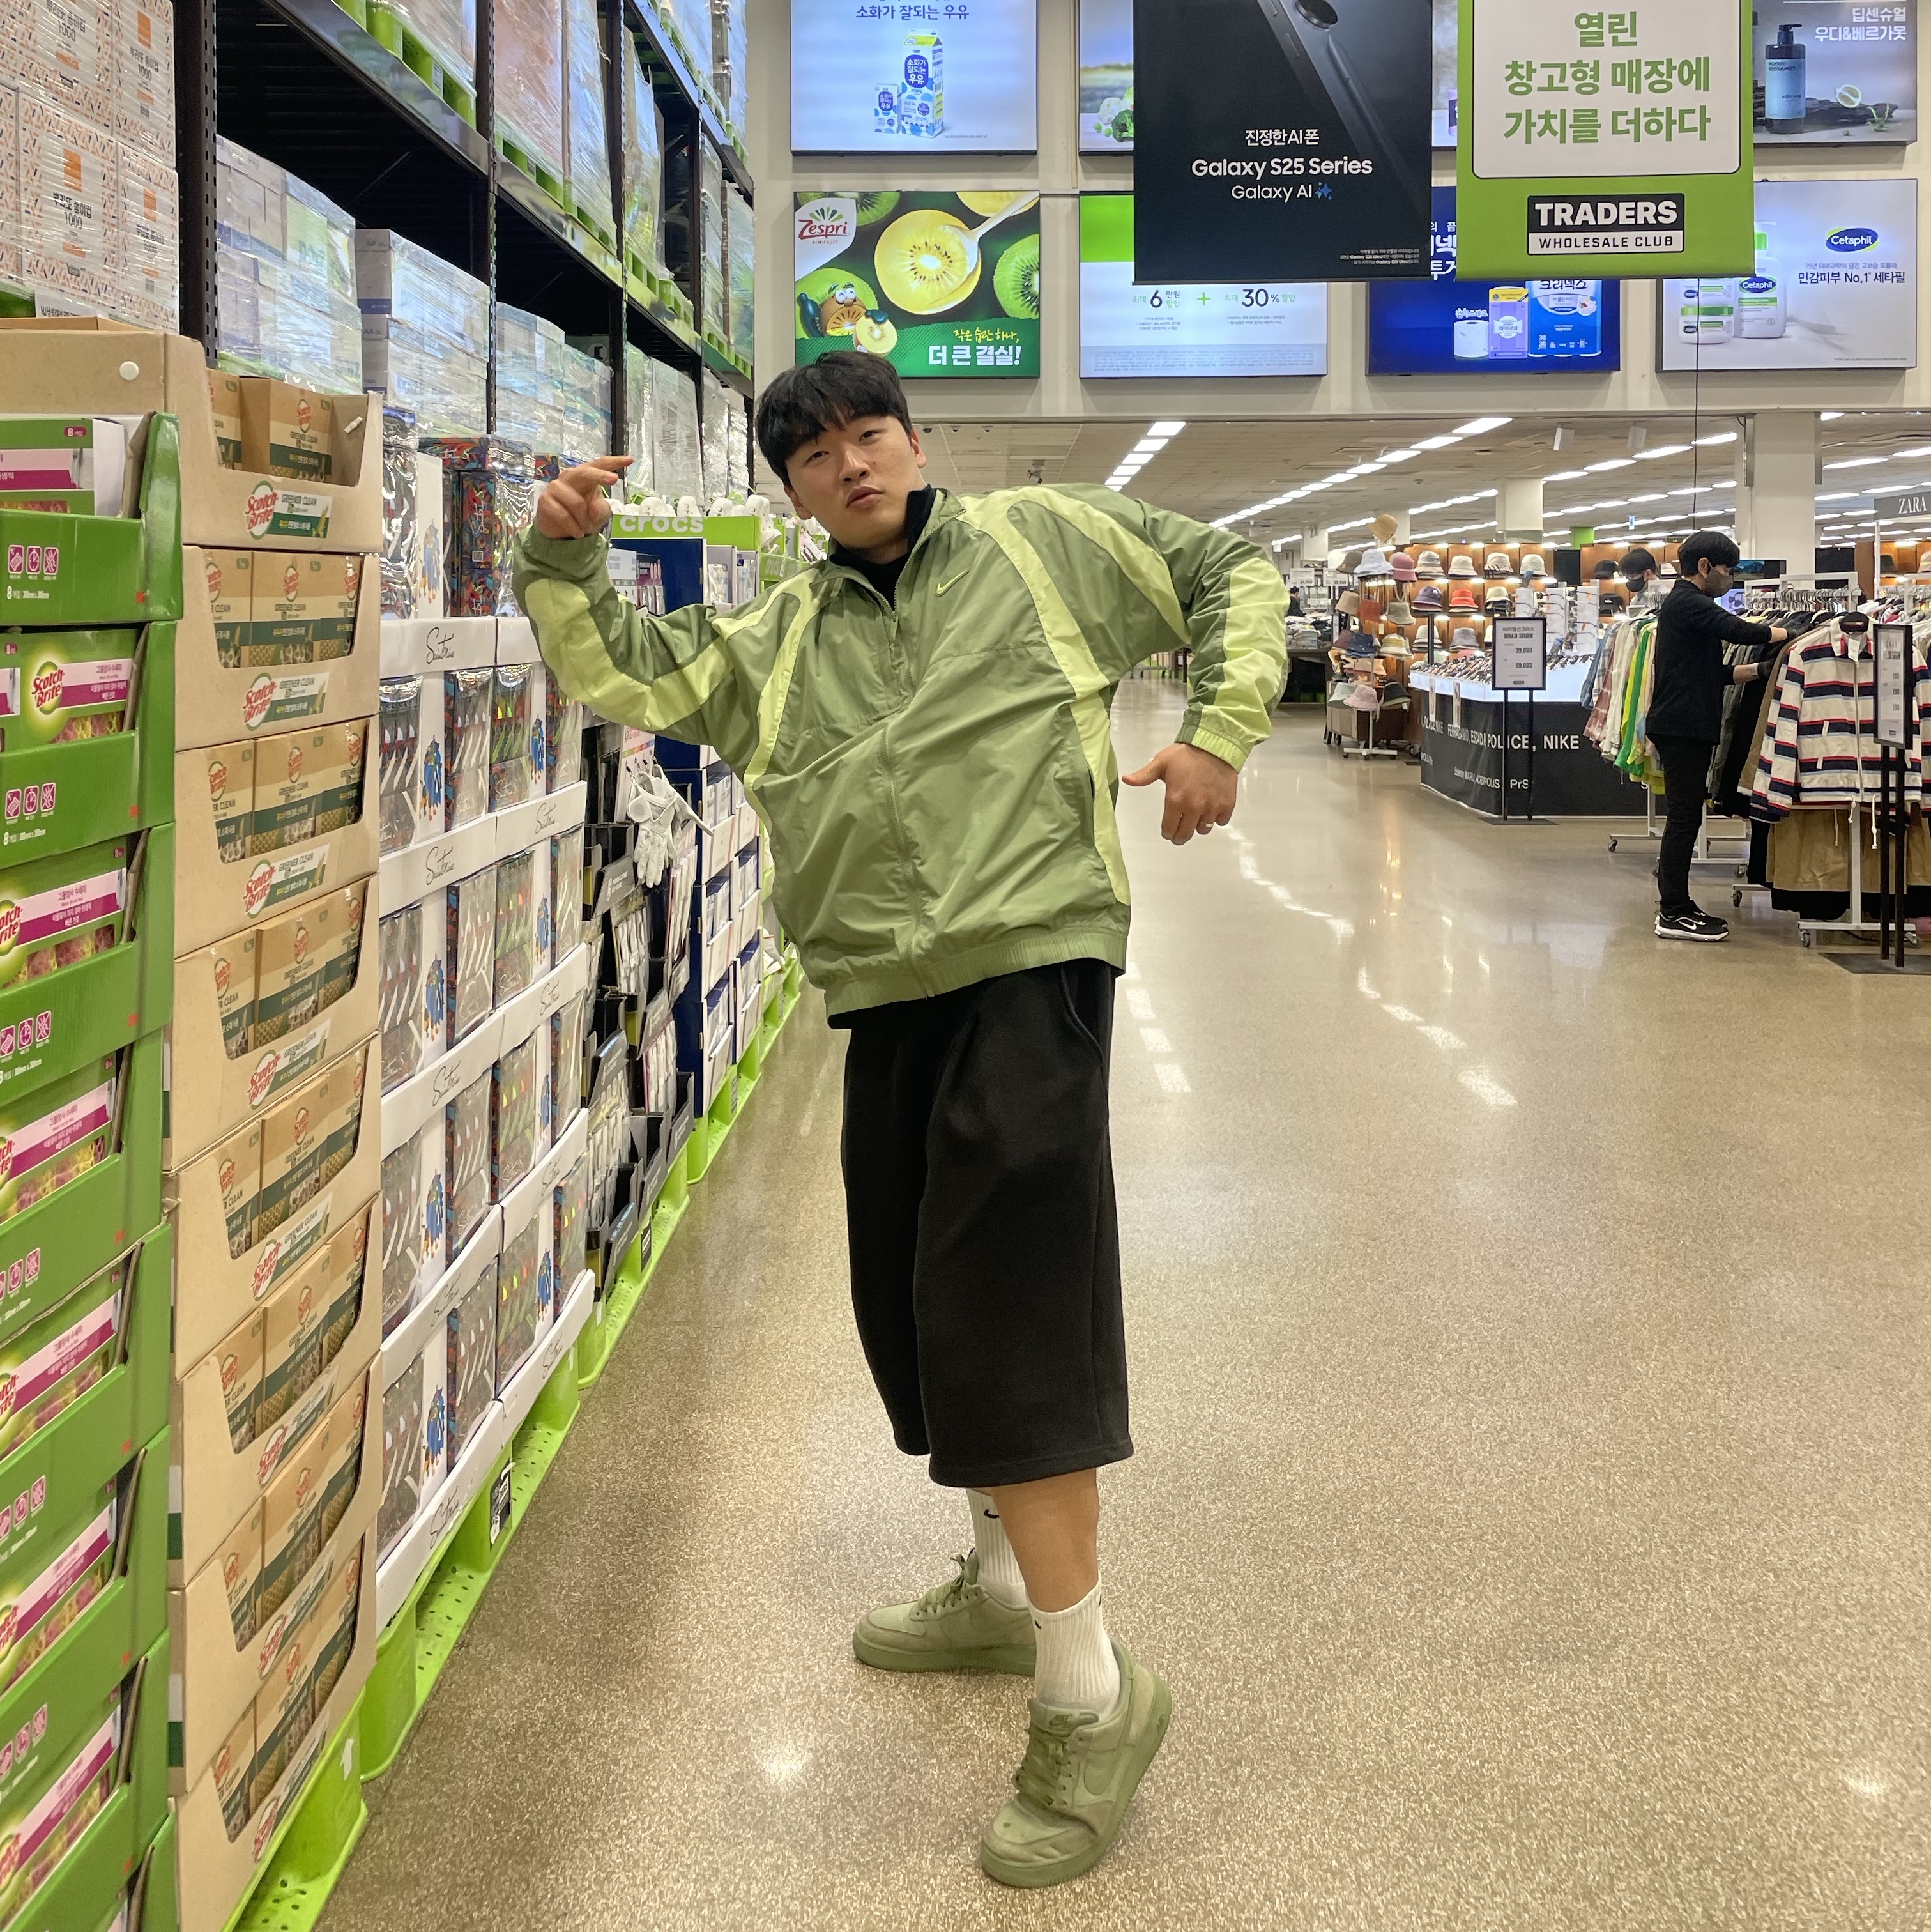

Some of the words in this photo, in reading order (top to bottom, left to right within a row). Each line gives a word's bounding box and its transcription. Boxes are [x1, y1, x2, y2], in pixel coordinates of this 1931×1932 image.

[856, 5, 896, 19] 소화가
[899, 5, 940, 20] 잘되는
[943, 4, 970, 20] 우유
[1852, 7, 1906, 22] 딥센슈얼
[1574, 11, 1638, 47] 열린
[1815, 26, 1907, 42] 우디&베르가못
[906, 66, 926, 75] 잘되는
[908, 73, 926, 85] 우유
[1504, 59, 1600, 95] 창고형
[1611, 56, 1710, 95] 매장에
[1503, 108, 1601, 144] 가치를
[1611, 105, 1711, 143] 더하다
[1191, 158, 1267, 180] Galaxy
[1270, 158, 1305, 176] S25
[1308, 155, 1373, 175] Series
[1232, 185, 1293, 203] Galaxy
[1297, 184, 1313, 198] AI
[1534, 200, 1678, 226] TRADERS
[798, 219, 850, 240] Zespri
[1538, 236, 1629, 249] WHOLESALE
[1635, 235, 1674, 247] CLUB
[1831, 235, 1872, 247] Cetaphil
[1742, 281, 1773, 290] Cetaphil
[1798, 272, 1842, 284] 민감피부
[1874, 271, 1905, 284] 세타필
[1133, 295, 1147, 303] 최대
[1150, 289, 1163, 308] 6
[1166, 291, 1180, 299] 만원
[1224, 293, 1239, 302] 최대
[953, 328, 972, 342] 작은
[974, 326, 994, 344] 습관
[995, 328, 1019, 344] 하나,
[929, 345, 947, 366] 더
[952, 345, 972, 366] 큰
[975, 345, 1022, 366] 결실!
[245, 491, 279, 515] Scotch-
[302, 495, 317, 507] CLEAN
[1898, 496, 1927, 514] ZARA
[248, 508, 275, 532] Brite
[620, 515, 704, 533] crocs
[31, 668, 66, 695] Scotch-
[36, 684, 62, 708] Brite
[242, 680, 277, 711] Scotch-
[244, 696, 271, 724] Brite
[1543, 735, 1580, 750] NIKE
[244, 879, 271, 916] Brite
[0, 904, 24, 930] otch-
